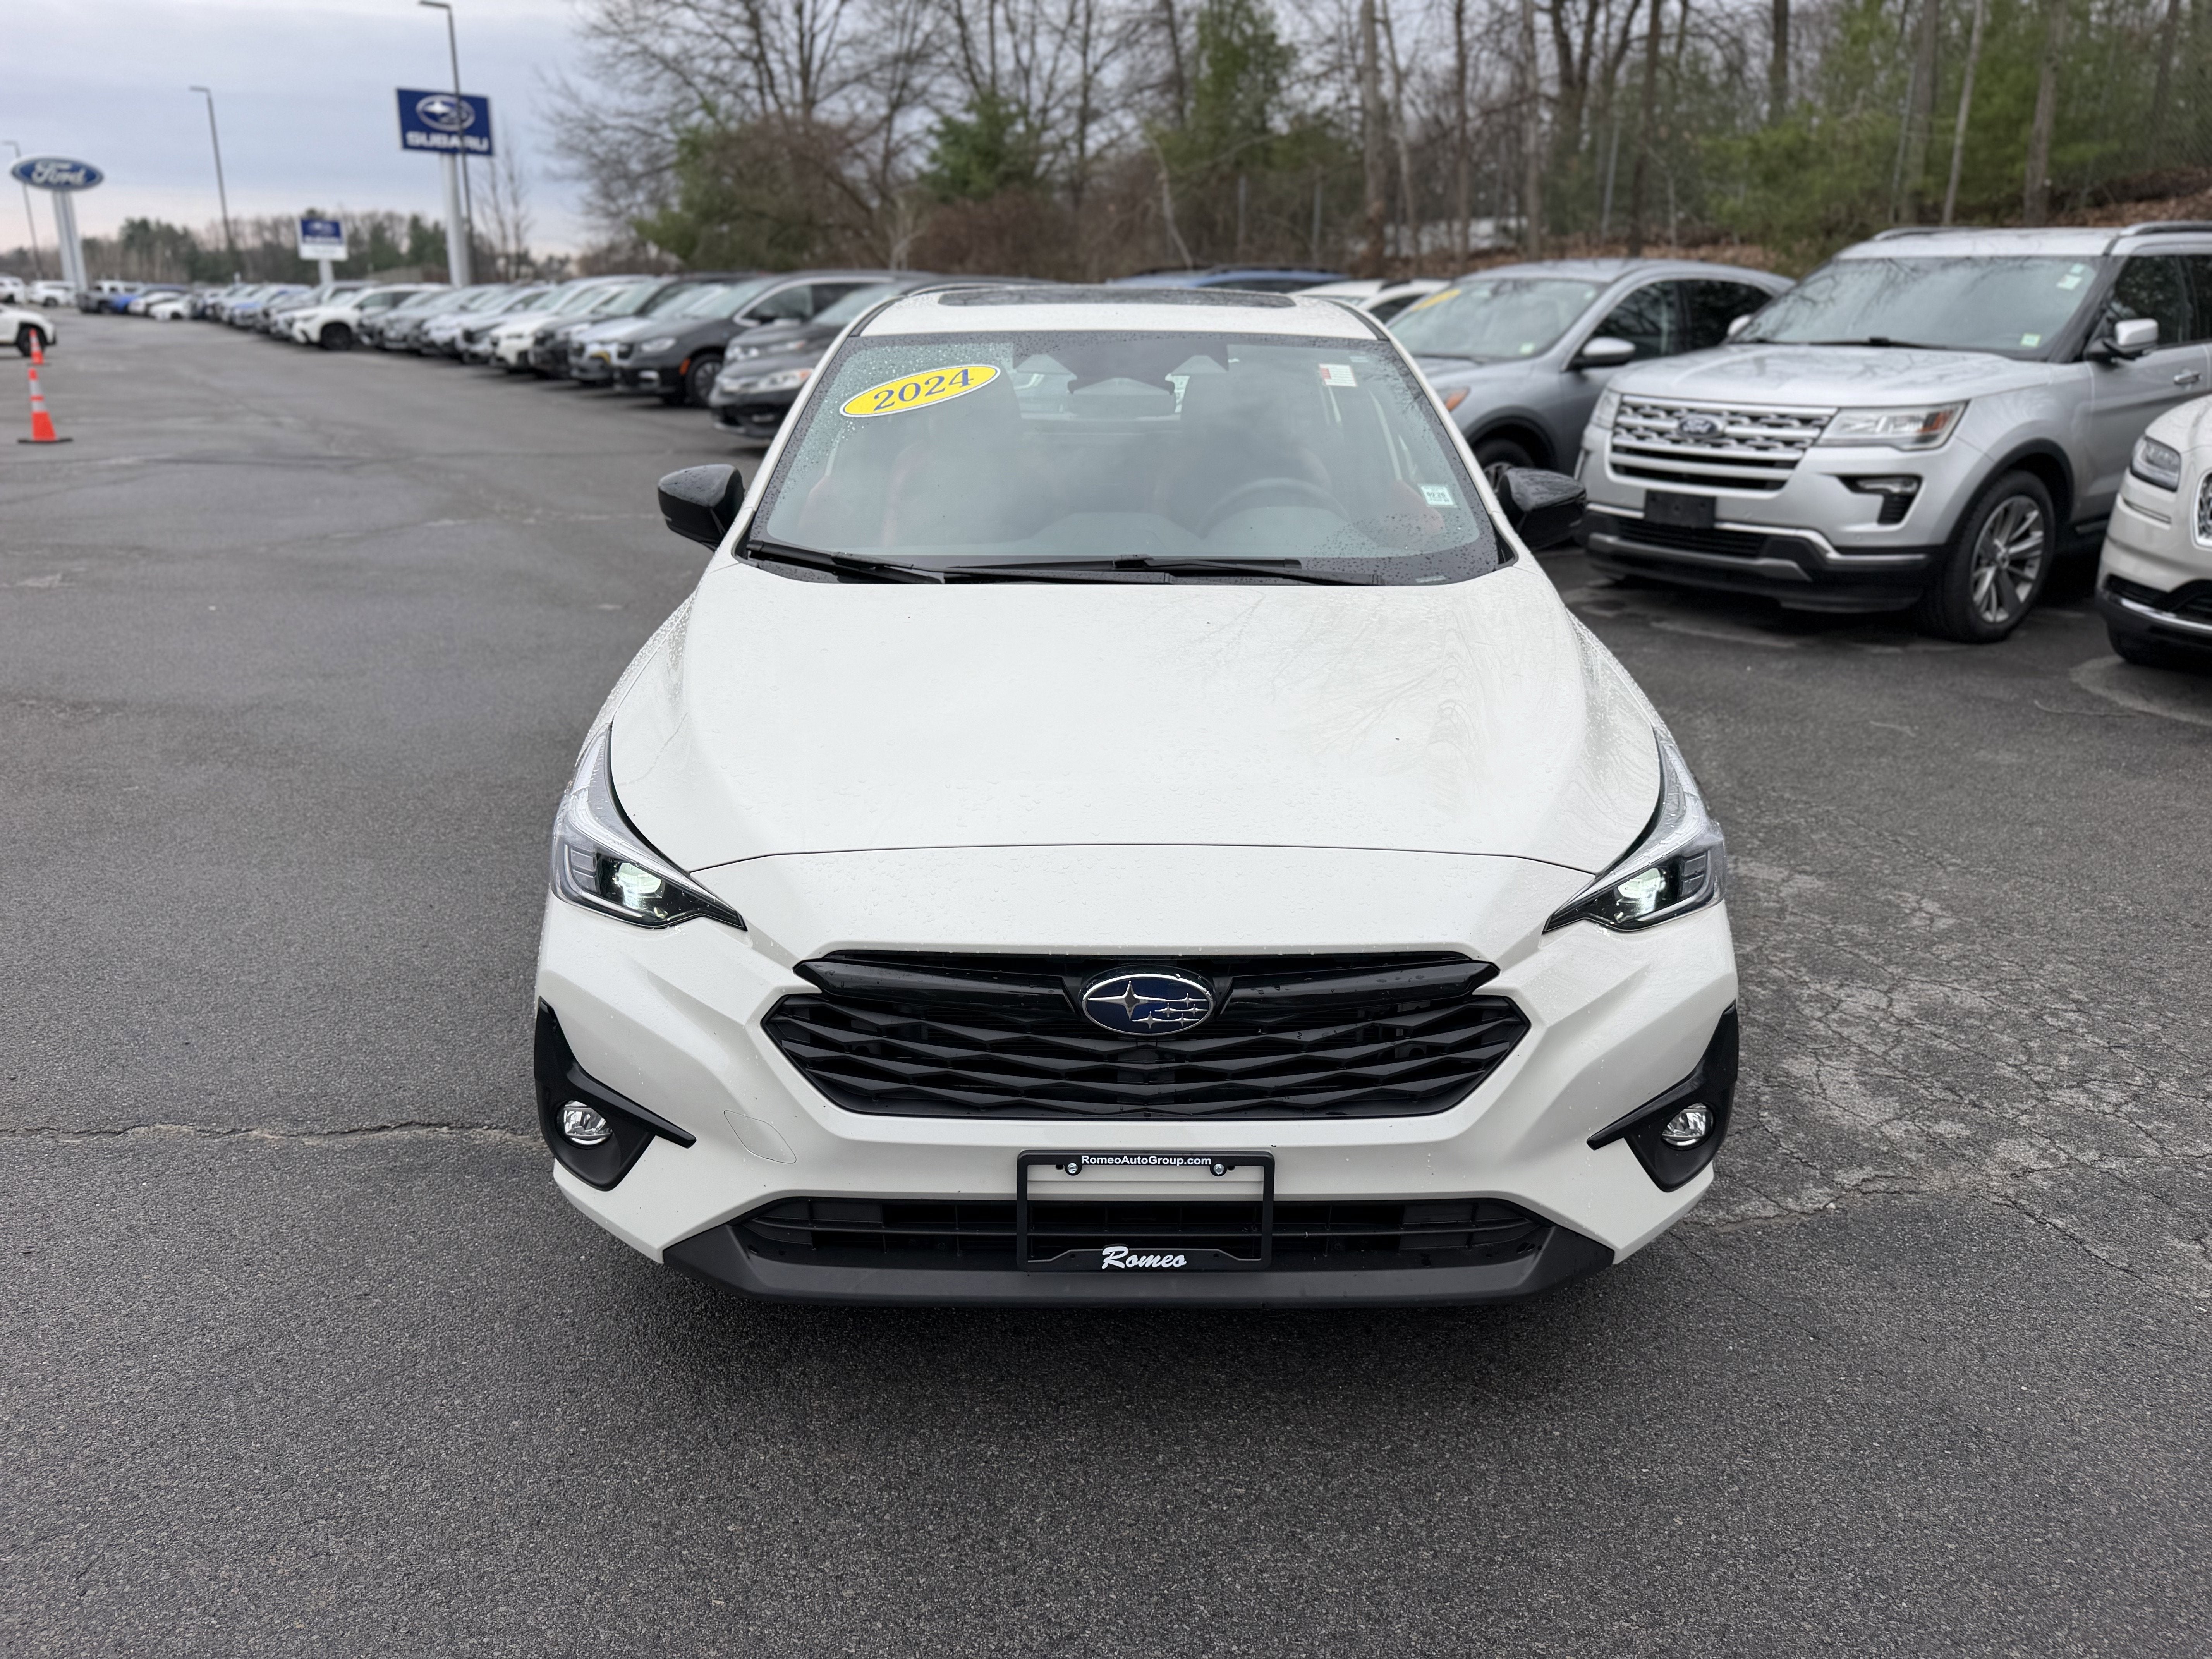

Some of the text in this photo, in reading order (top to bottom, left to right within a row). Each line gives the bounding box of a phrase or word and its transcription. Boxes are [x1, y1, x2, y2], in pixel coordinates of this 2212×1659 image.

[31, 160, 86, 185] Ford
[873, 368, 974, 412] 2024
[1683, 418, 1712, 434] Ford
[1081, 1155, 1212, 1166] RomeoAutoGroup.com
[1101, 1246, 1187, 1269] Romeo
